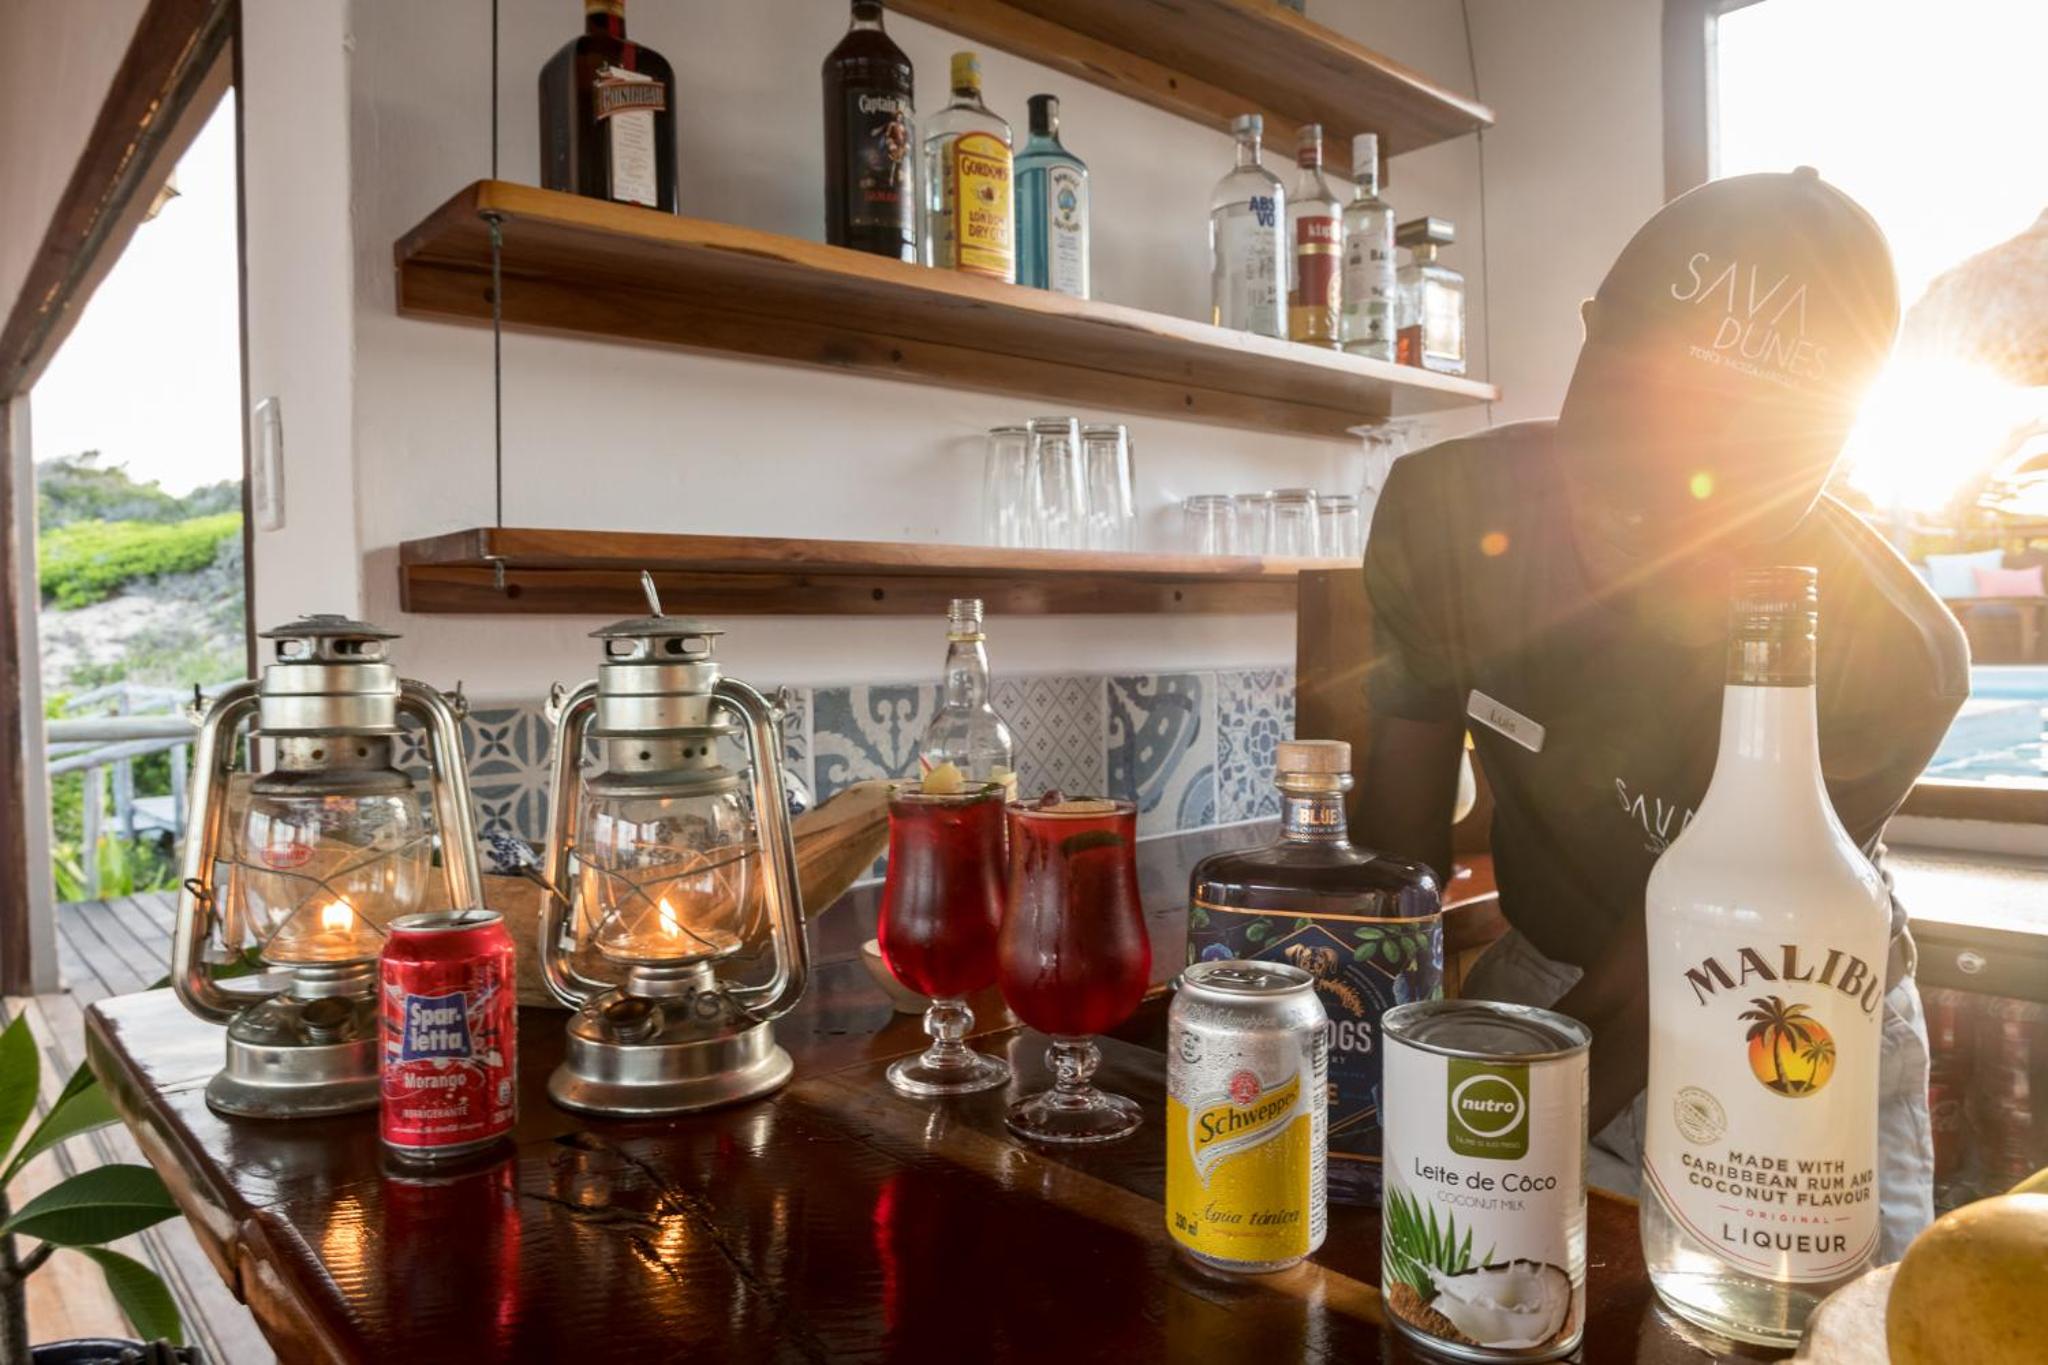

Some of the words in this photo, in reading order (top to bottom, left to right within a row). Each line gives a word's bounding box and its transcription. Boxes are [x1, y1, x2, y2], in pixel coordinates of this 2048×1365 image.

[968, 224, 989, 239] DRY
[1671, 252, 1807, 337] SAVA
[1713, 316, 1827, 379] DUNES
[1299, 806, 1339, 825] BLUE
[1684, 944, 1882, 1014] MALIBU
[410, 1029, 464, 1052] letta
[404, 1072, 466, 1090] Morango
[1462, 1099, 1515, 1113] nutro
[1681, 1153, 1798, 1190] CARIBBEAN
[1807, 1177, 1845, 1191] RUM
[1850, 1169, 1873, 1187] AND
[1729, 1151, 1789, 1172] MADE
[1796, 1160, 1845, 1174] WITH
[1415, 1157, 1460, 1186] Leite
[1466, 1171, 1495, 1191] de
[1502, 1173, 1557, 1193] Côco
[1437, 1190, 1497, 1211] COCONUT
[1500, 1200, 1526, 1212] MILK
[1688, 1172, 1788, 1204] COCONUT
[1796, 1187, 1871, 1207] FLAVOUR
[1746, 1208, 1830, 1224] ORIGINAL
[1722, 1223, 1847, 1254] LIQUEUR
